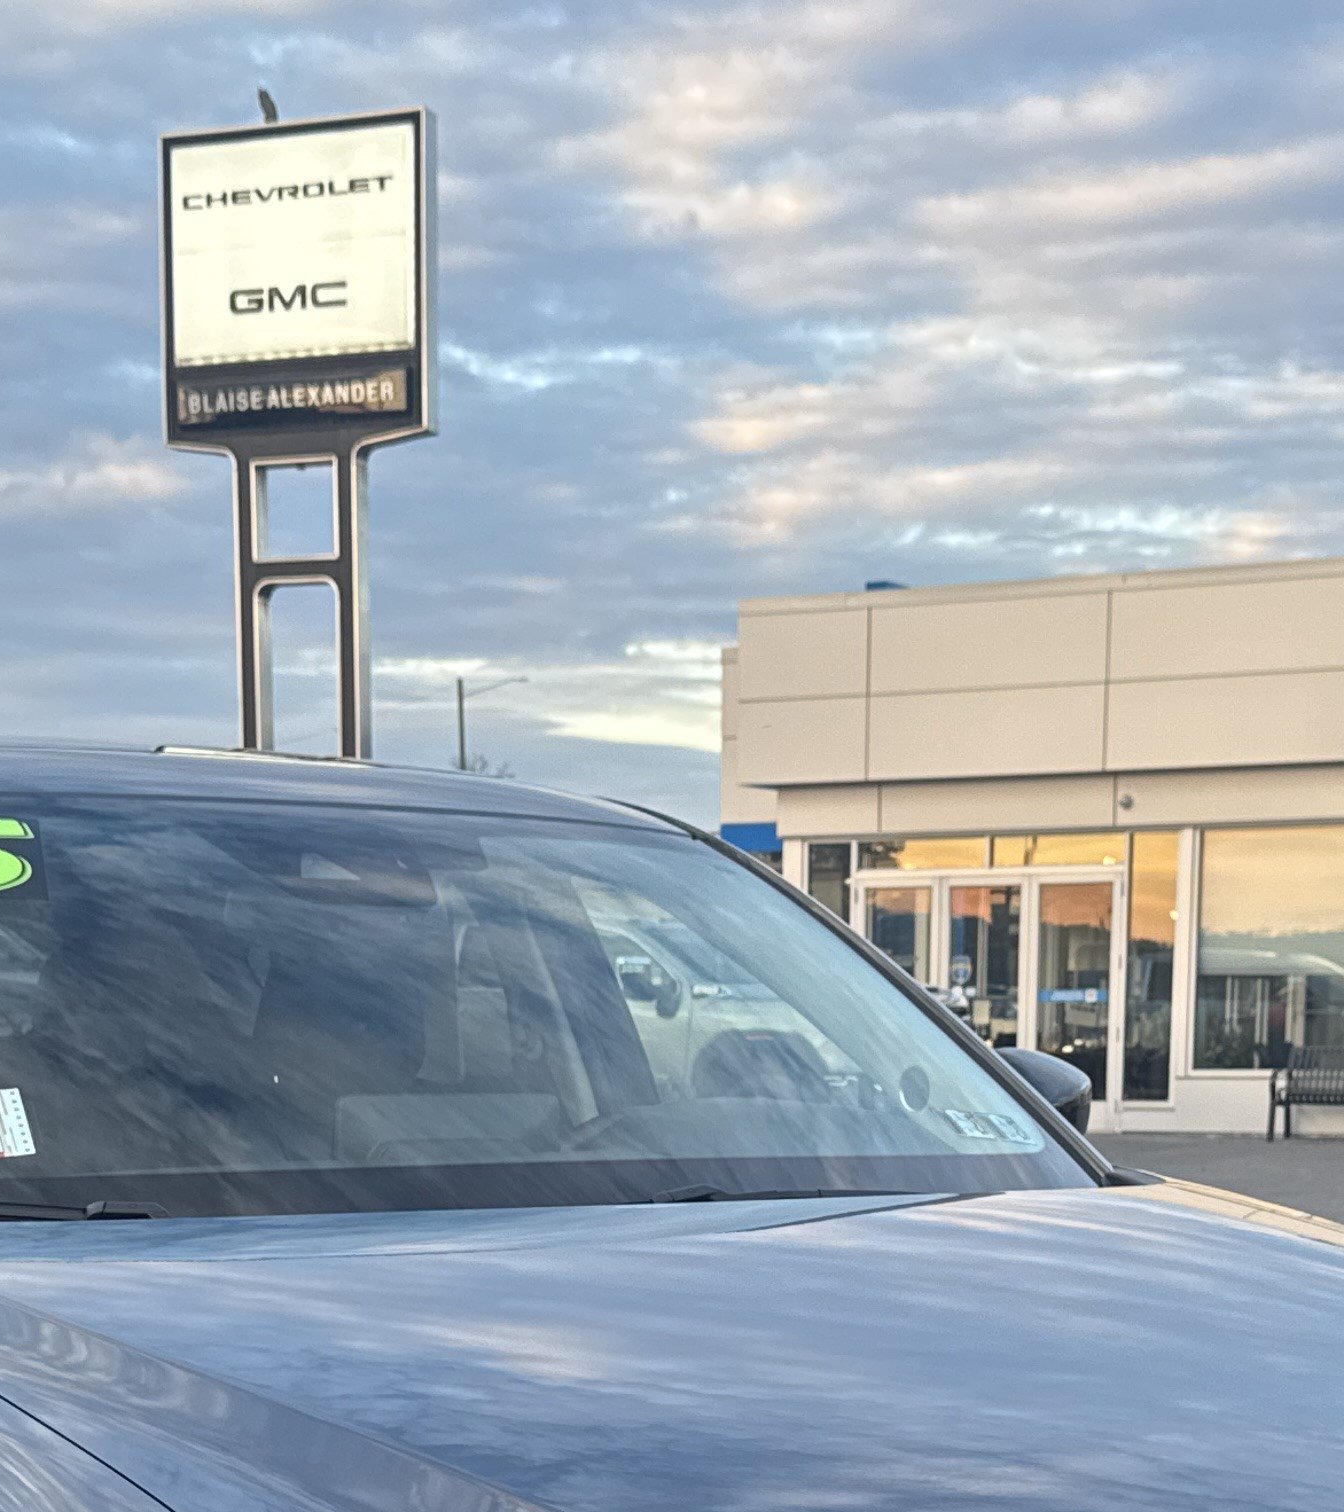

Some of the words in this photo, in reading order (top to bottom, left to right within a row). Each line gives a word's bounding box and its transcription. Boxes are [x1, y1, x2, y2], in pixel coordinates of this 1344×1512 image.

[182, 174, 394, 211] CHEVROLET
[229, 281, 347, 315] GMC
[186, 386, 264, 415] BLAISE
[266, 379, 395, 411] ALEXANDER
